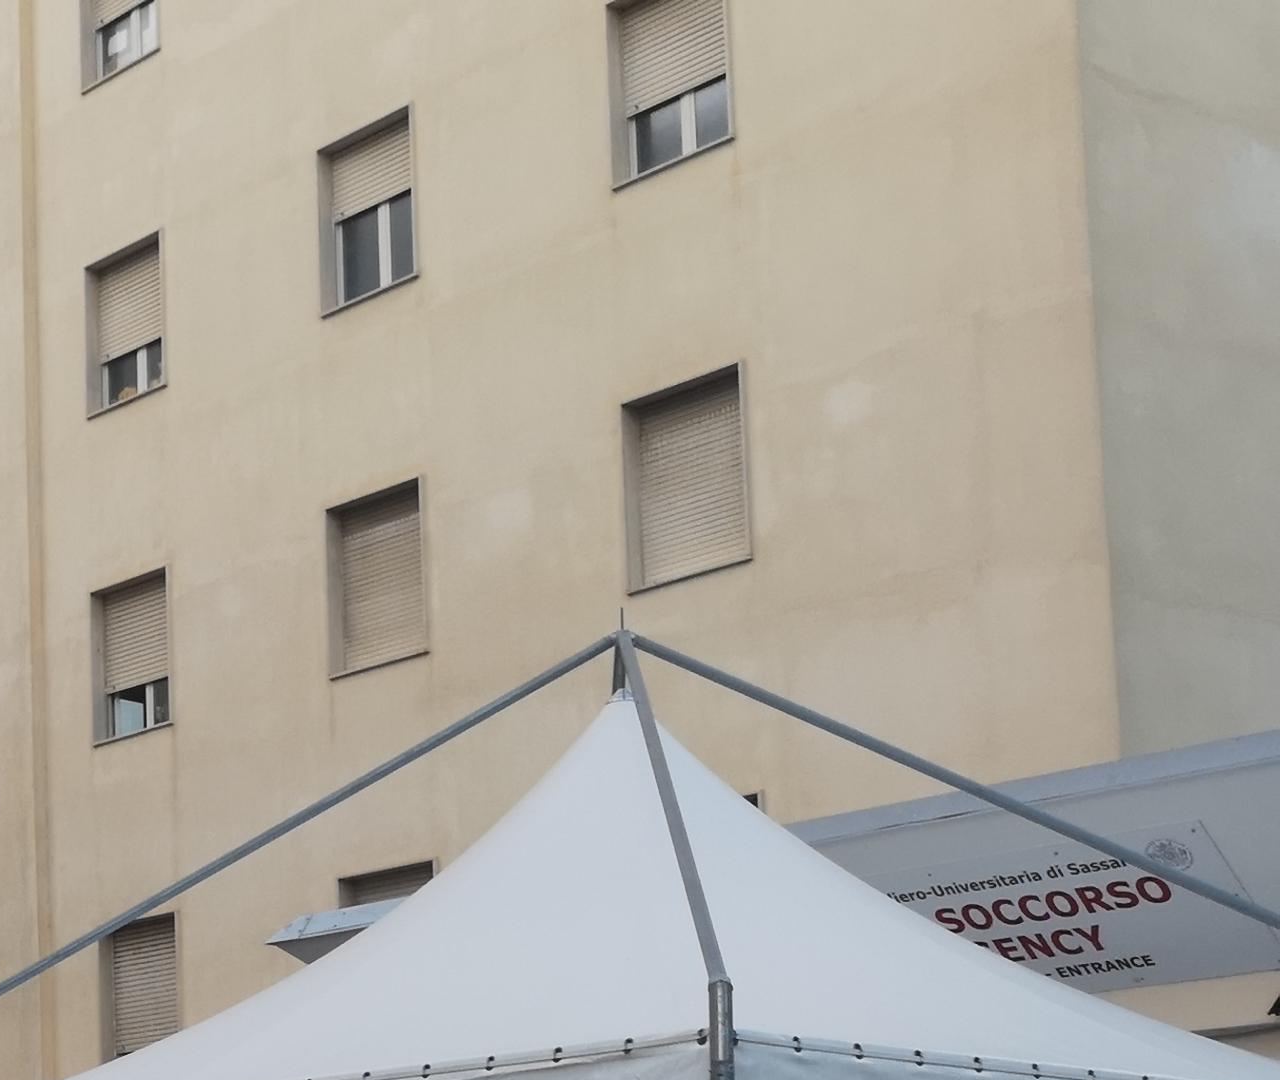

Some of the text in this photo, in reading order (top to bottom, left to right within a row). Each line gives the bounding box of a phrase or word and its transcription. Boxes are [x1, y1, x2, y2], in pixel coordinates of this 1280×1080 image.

[1046, 865, 1064, 880] di
[934, 876, 1173, 934] SOCCORSO
[972, 924, 1105, 963] ENCY
[1056, 955, 1157, 978] ENTRANCE
